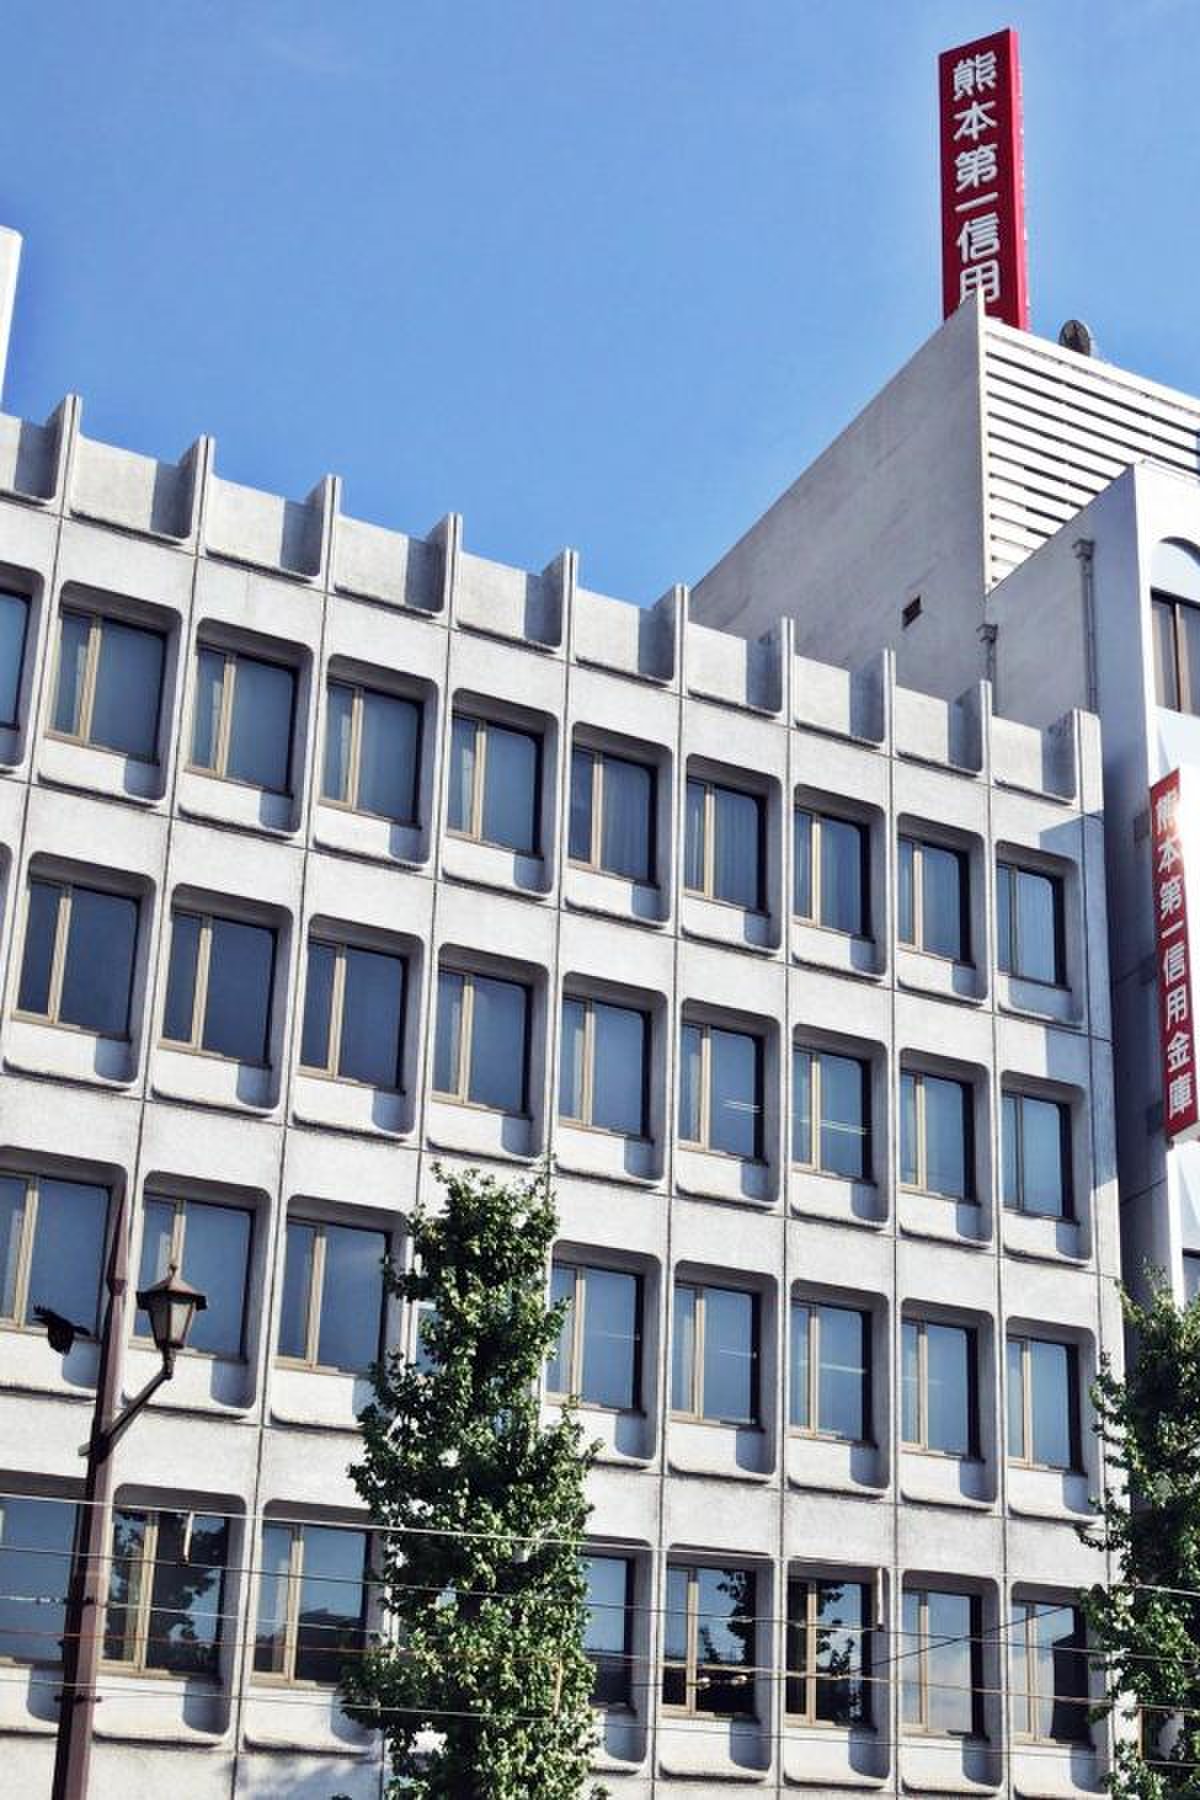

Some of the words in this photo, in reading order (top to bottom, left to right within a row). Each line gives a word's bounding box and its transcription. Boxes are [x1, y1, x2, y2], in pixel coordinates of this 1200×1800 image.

[1156, 788, 1193, 1121] 熊本第一信用金庫
